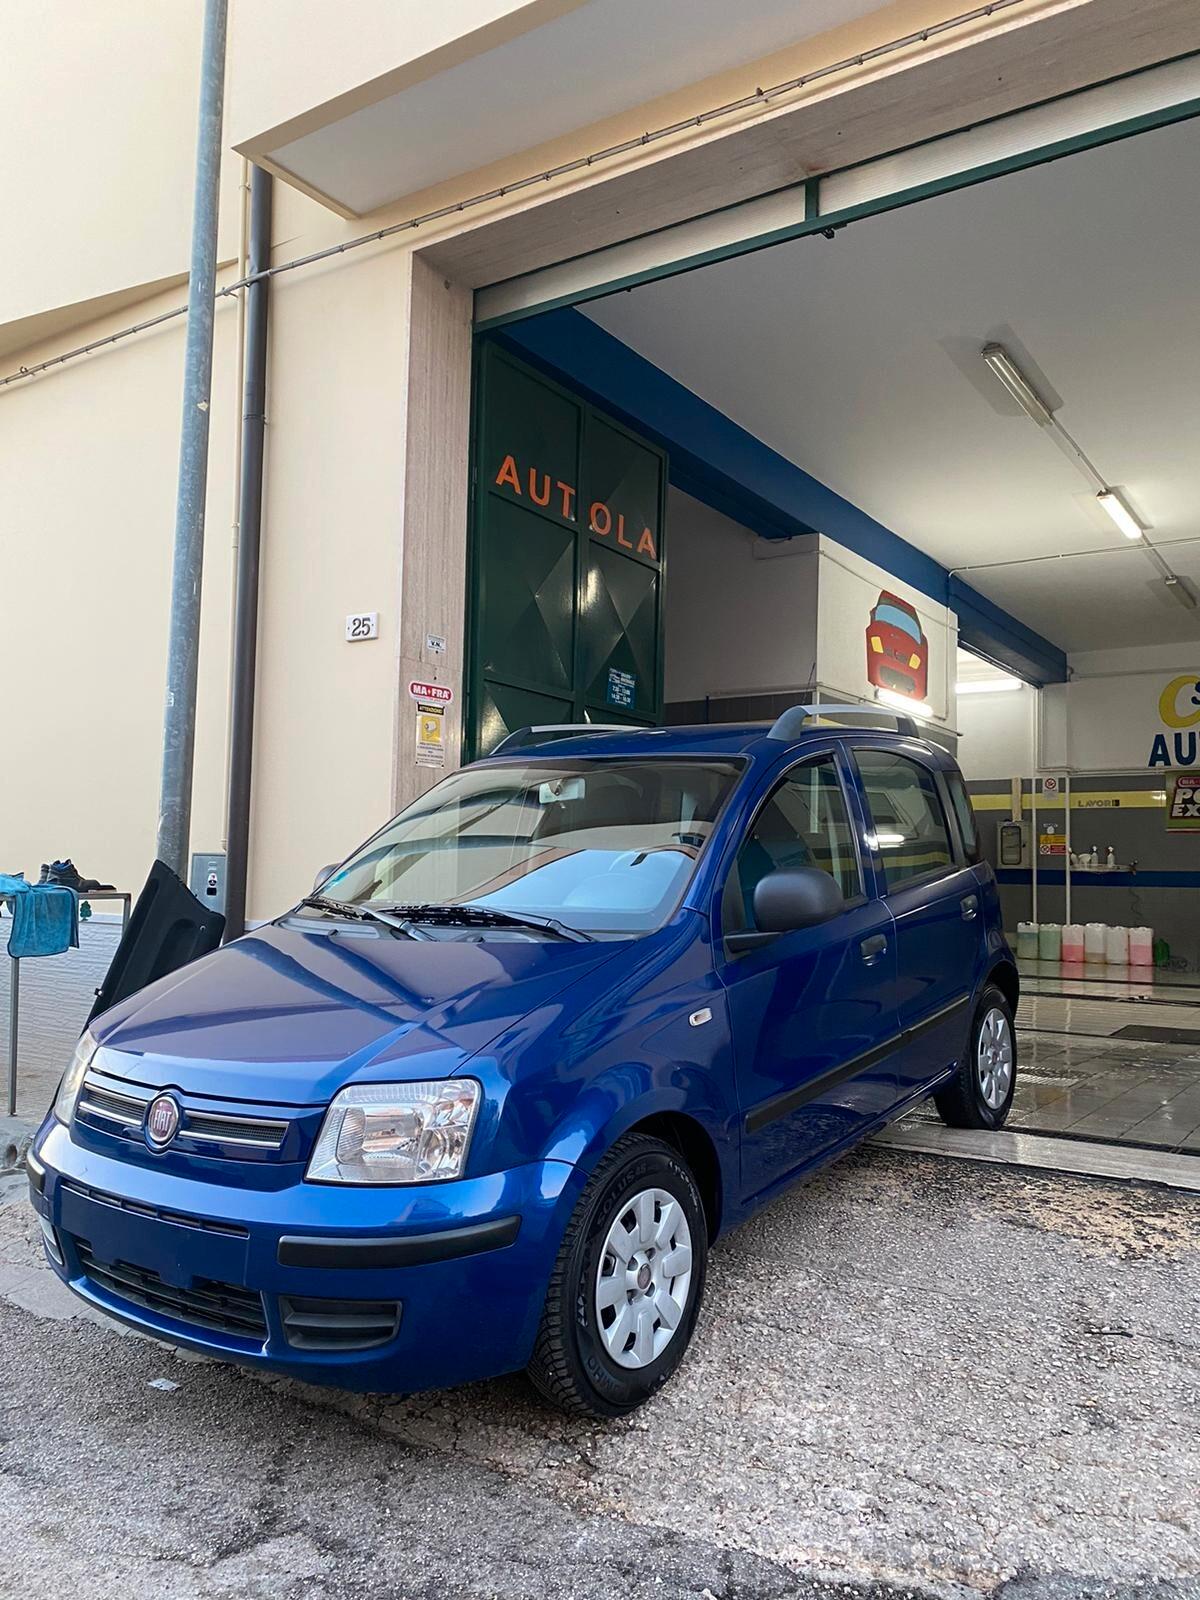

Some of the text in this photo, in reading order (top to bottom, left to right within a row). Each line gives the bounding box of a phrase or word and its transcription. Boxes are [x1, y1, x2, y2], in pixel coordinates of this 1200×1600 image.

[351, 617, 371, 637] 25
[1149, 732, 1200, 767] AU
[153, 1109, 173, 1132] FIAT
